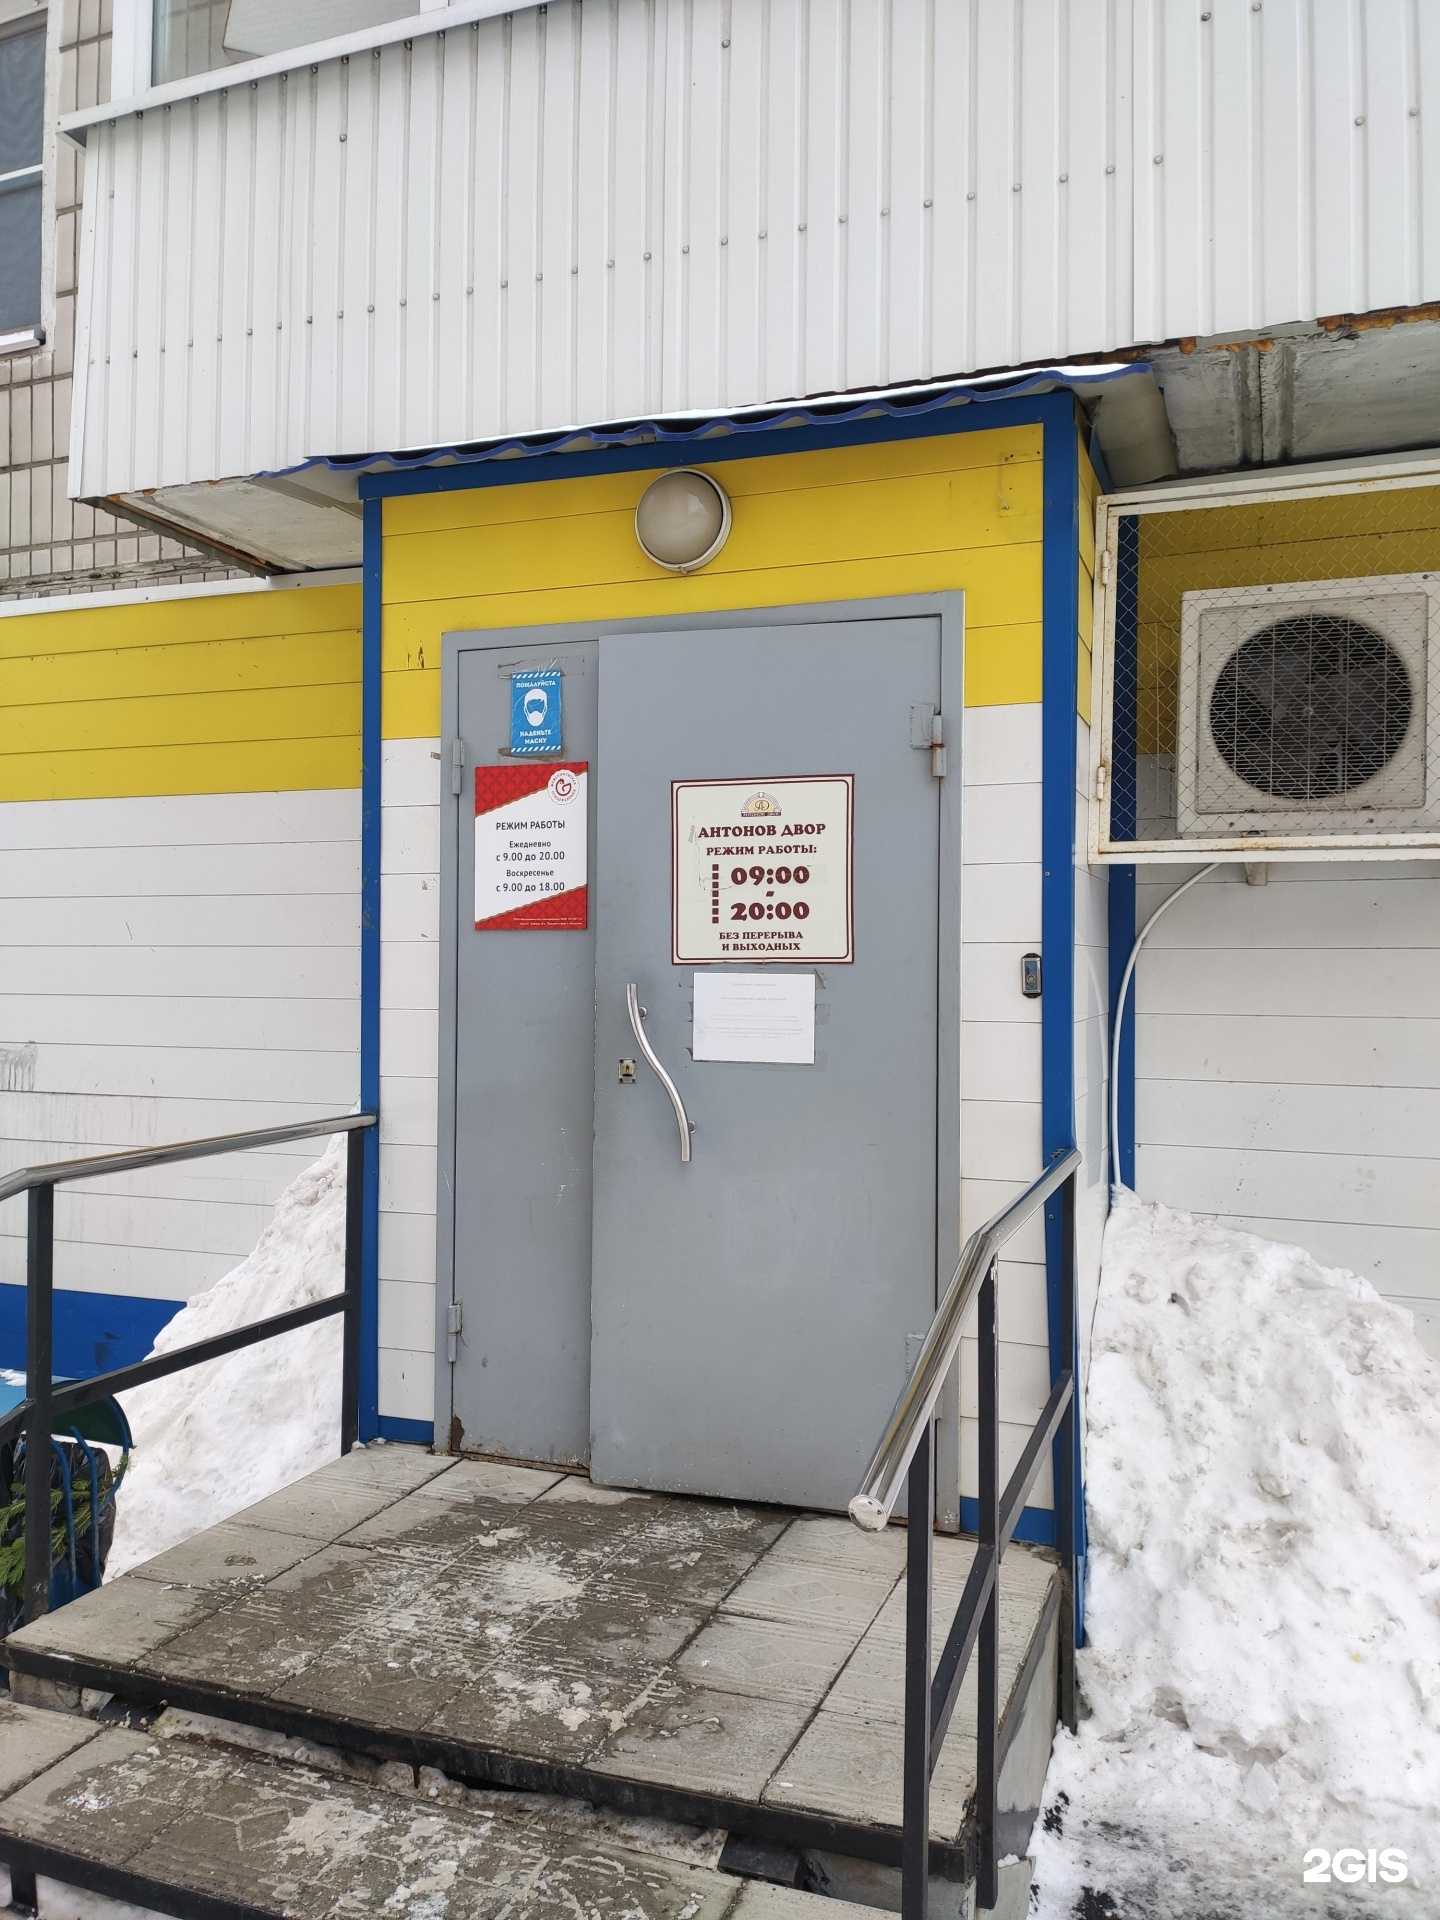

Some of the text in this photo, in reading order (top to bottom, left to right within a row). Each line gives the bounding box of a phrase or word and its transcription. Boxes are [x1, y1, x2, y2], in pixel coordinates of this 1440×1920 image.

[516, 680, 556, 688] ПОЖАЛУЙСТА
[520, 729, 552, 737] НАДЕНЬТЕ
[496, 820, 565, 830] РЕЖИМ РАБОТЫ
[698, 823, 826, 838] АНТОНОВ ДВОР
[509, 840, 551, 848] Ежедневно
[706, 844, 817, 856] РЕЖИМ РАБОТЫ:
[503, 852, 523, 861] 9.00
[525, 854, 536, 862] до
[539, 851, 565, 860] 20.00
[506, 869, 554, 878] Воскресенье
[731, 866, 810, 886] 09:00
[503, 883, 523, 892] 9.00
[540, 882, 565, 891] 18.00
[731, 901, 810, 921] 20:00
[719, 931, 803, 940] БЕЗ ПЕРЕРЫВА
[722, 942, 801, 951] И ВЫХОДНЫХ
